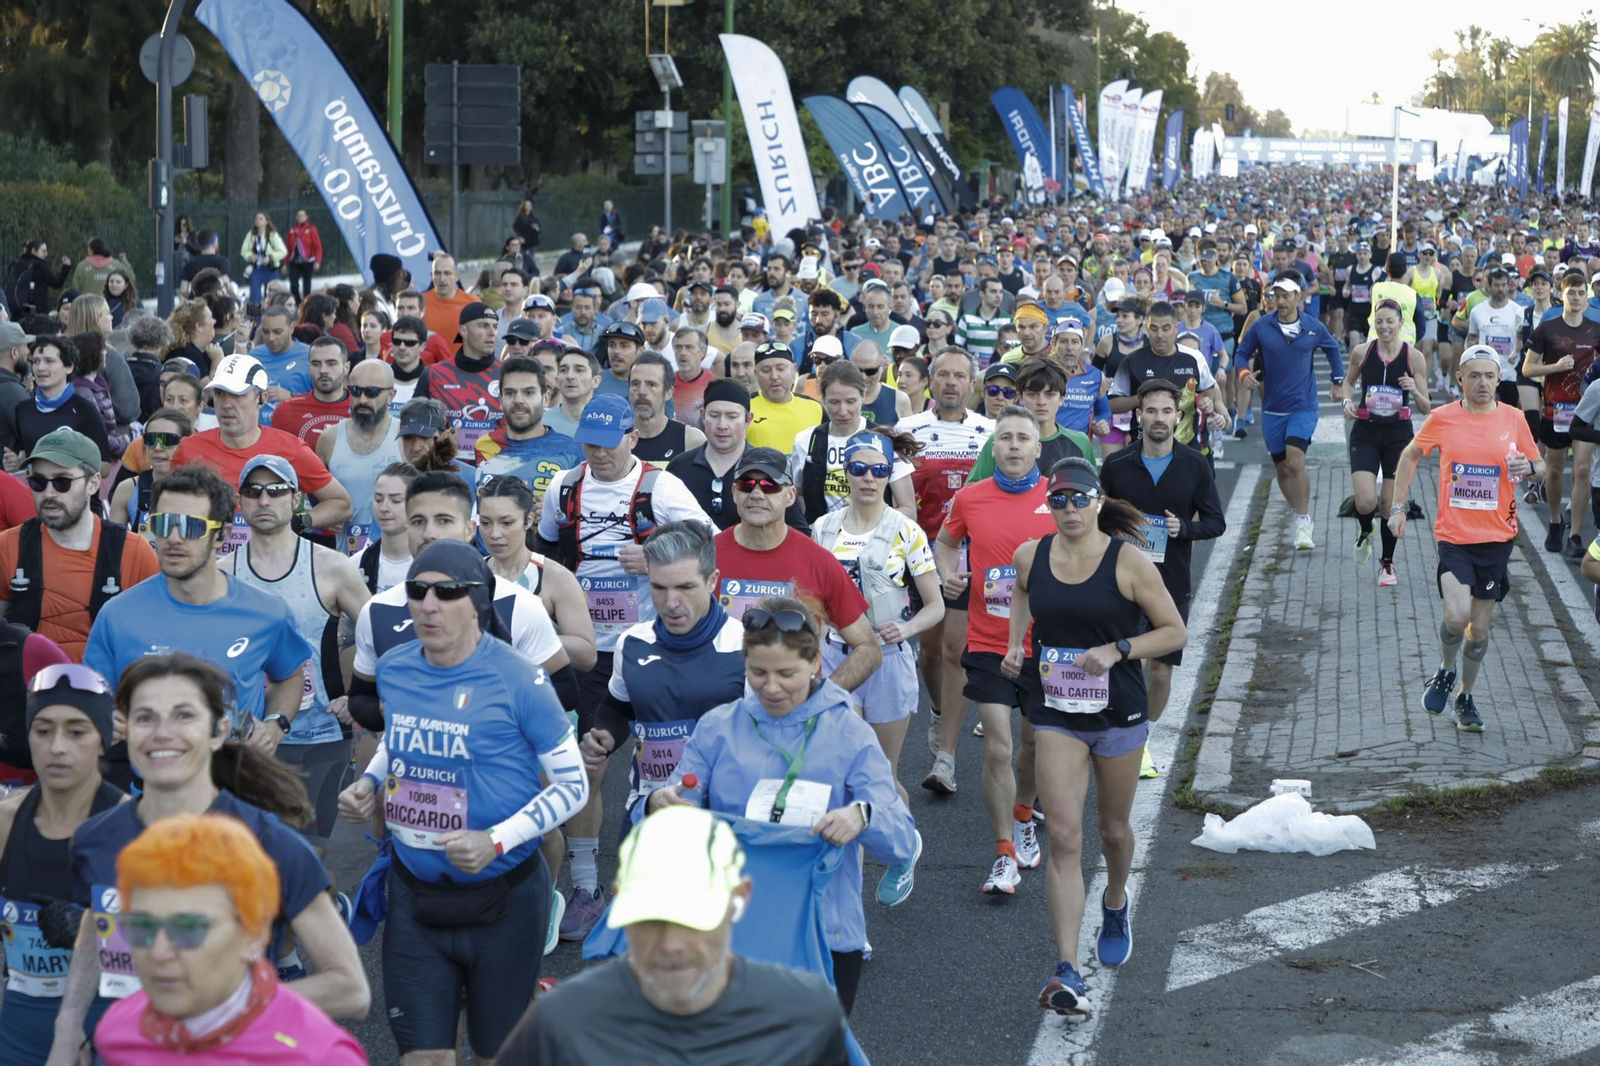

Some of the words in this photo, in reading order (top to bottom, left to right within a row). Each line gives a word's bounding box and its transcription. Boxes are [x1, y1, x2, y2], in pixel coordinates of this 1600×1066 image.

[586, 411, 613, 422] ASAB
[1466, 467, 1495, 475] ZURICH
[1454, 488, 1493, 499] MICKAEL
[228, 532, 248, 540] 9536
[594, 581, 629, 589] ZURICH
[744, 584, 786, 595] ZURICH
[596, 598, 615, 606] 8453
[589, 609, 626, 620] FELIPE
[1061, 671, 1086, 681] 10002
[1068, 688, 1108, 699] CARTER
[419, 718, 469, 736] MARATHON
[647, 725, 688, 738] ZURICH
[388, 725, 471, 760] ITALIA
[652, 748, 673, 759] 8414
[409, 766, 456, 784] ZURICH
[408, 790, 438, 805] 10088
[386, 802, 462, 830] RICCARDO
